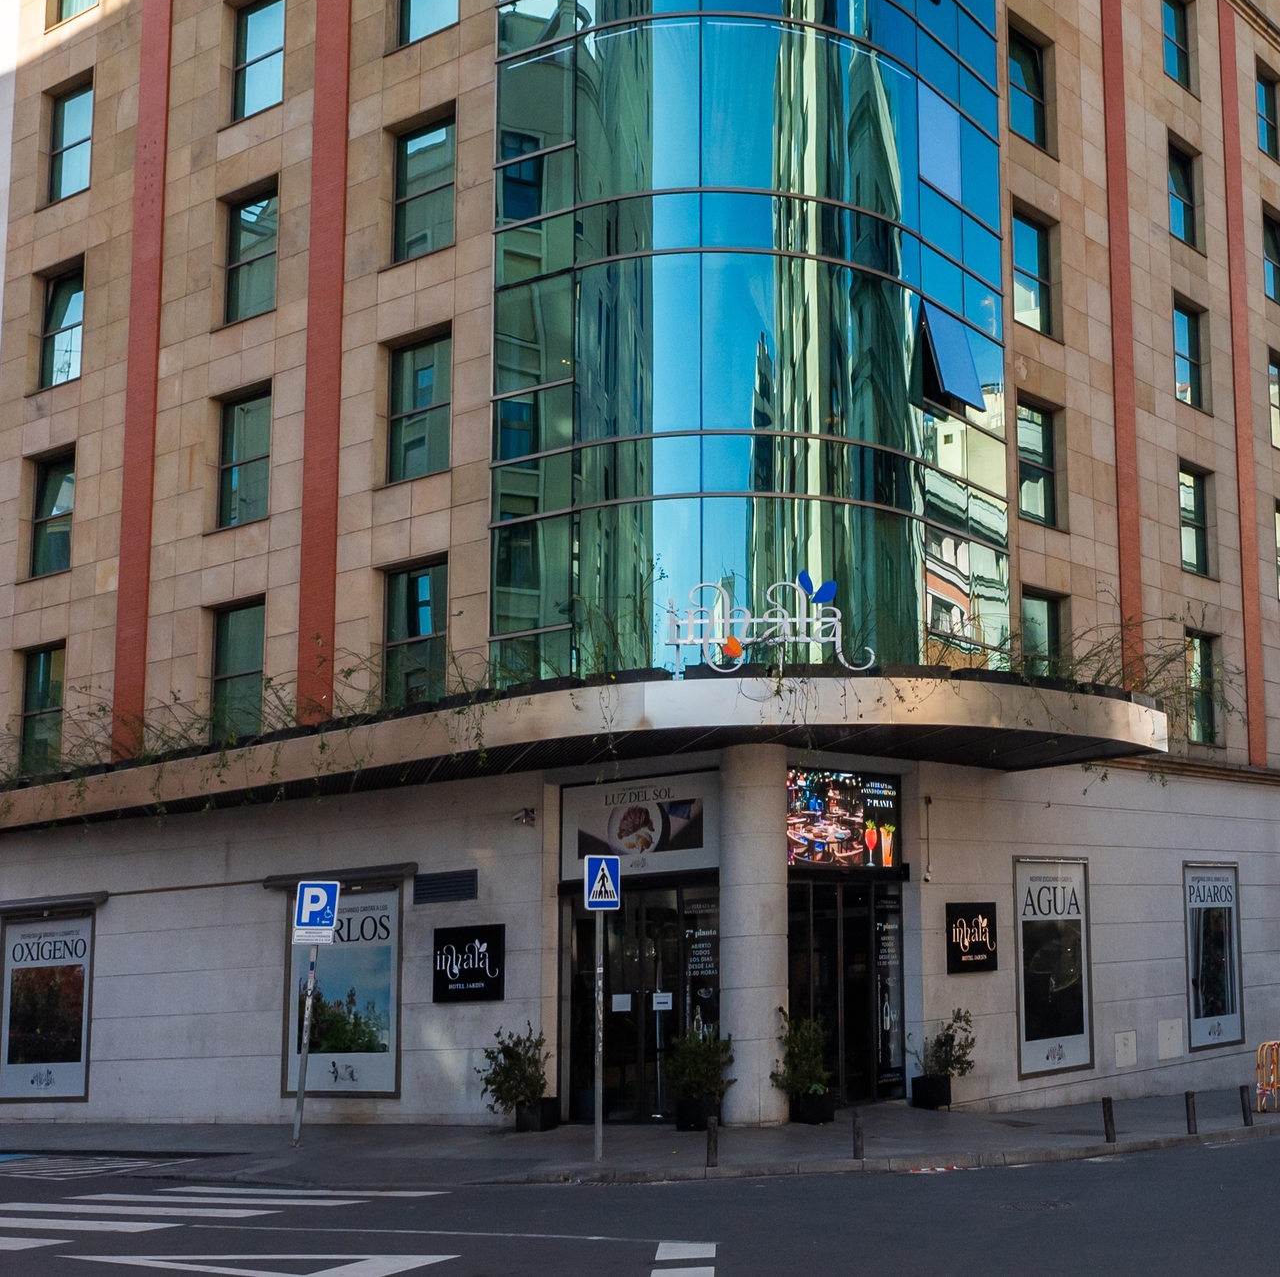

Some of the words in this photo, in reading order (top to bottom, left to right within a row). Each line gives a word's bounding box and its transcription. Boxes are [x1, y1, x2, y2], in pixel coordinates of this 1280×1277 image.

[665, 581, 876, 673] inhala
[604, 793, 627, 806] LUZ
[628, 790, 651, 803] DEL
[652, 787, 675, 801] SOL
[873, 799, 893, 808] PLANTA
[1022, 886, 1082, 916] AGUA
[1188, 880, 1233, 903] PÁJAROS
[301, 888, 328, 923] P
[334, 914, 391, 943] RLOS
[694, 929, 717, 938] planta
[883, 922, 898, 931] planta
[952, 918, 996, 952] inhala
[12, 936, 87, 962] OXÍGENO
[436, 942, 499, 980] inhala
